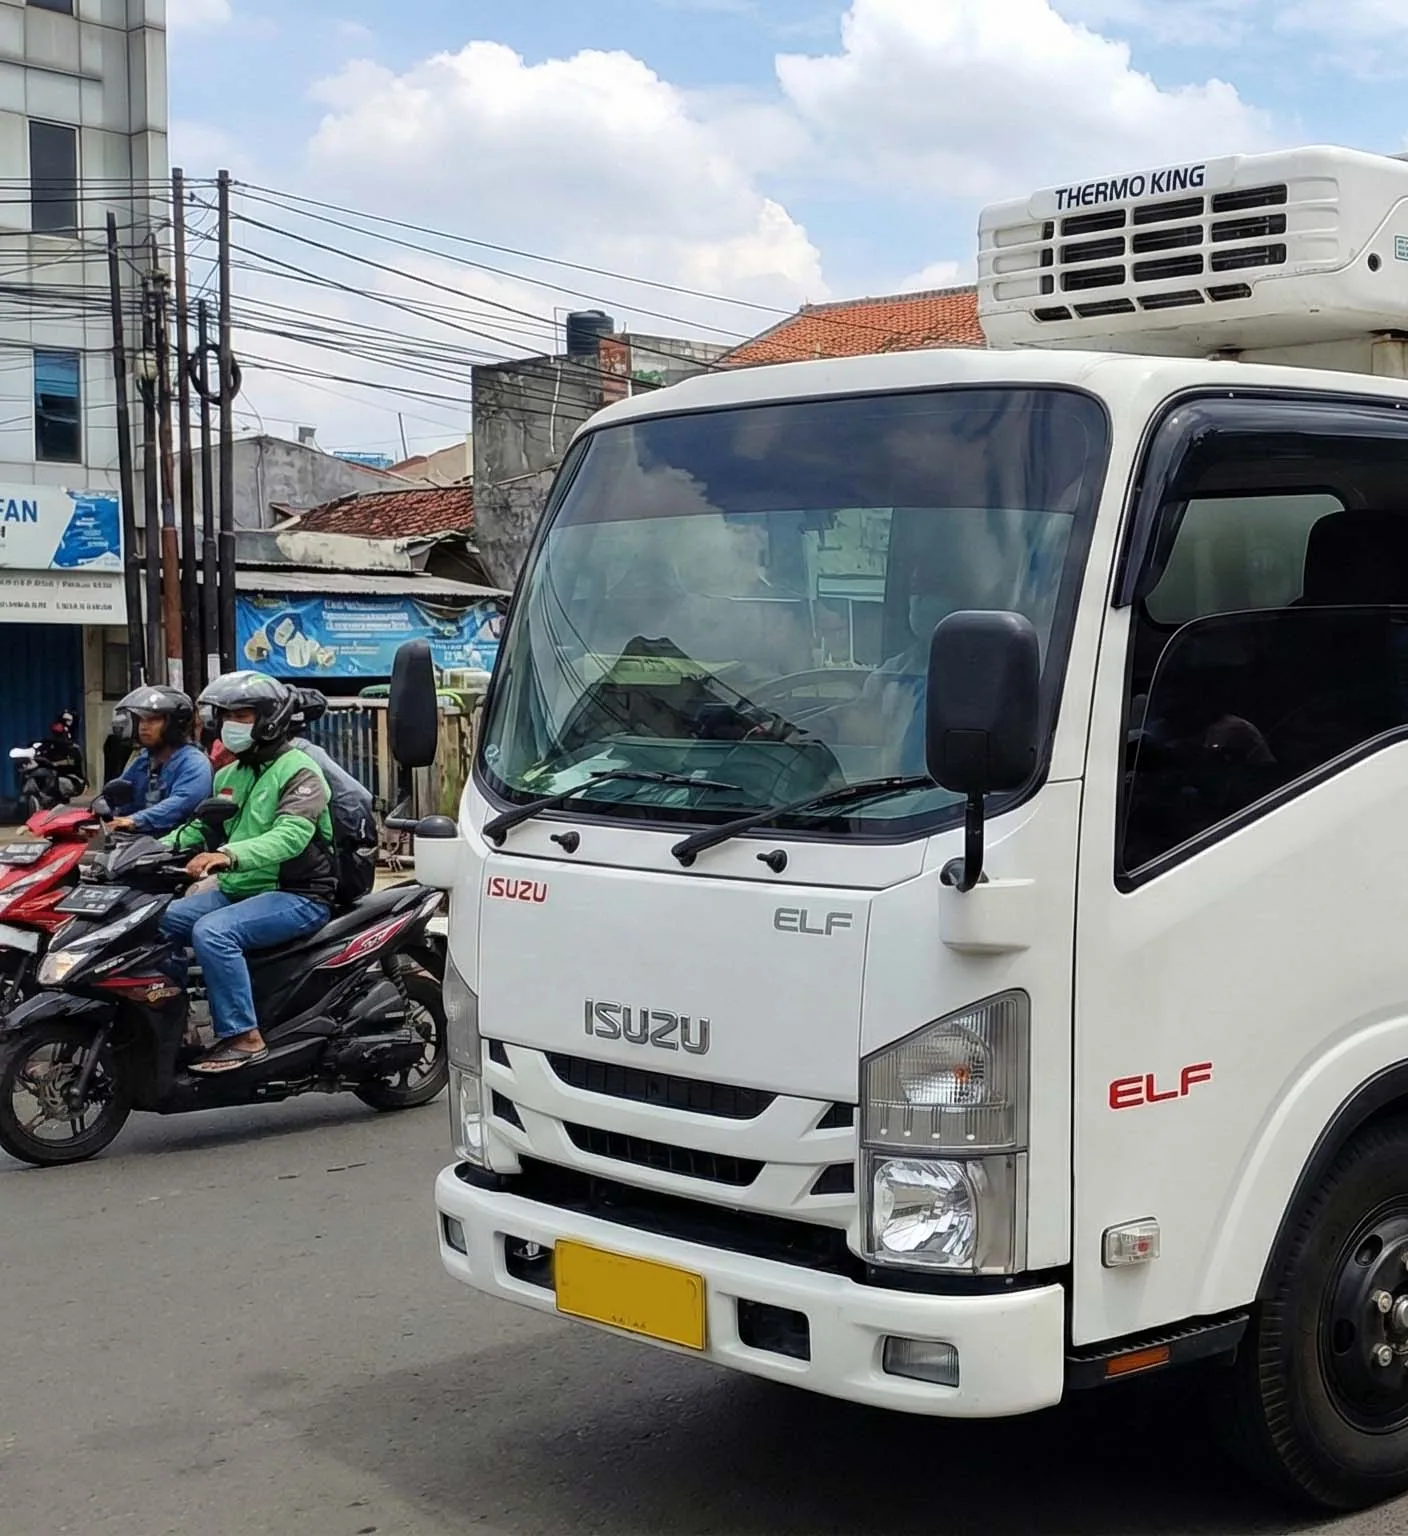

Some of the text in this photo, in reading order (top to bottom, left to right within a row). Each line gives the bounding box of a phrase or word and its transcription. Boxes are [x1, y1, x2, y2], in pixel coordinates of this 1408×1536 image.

[1055, 164, 1206, 210] THERMO KING
[486, 876, 548, 903] ISUZU
[773, 907, 853, 936] ELF
[584, 998, 711, 1056] ISUZU
[1109, 1062, 1213, 1110] ELF
